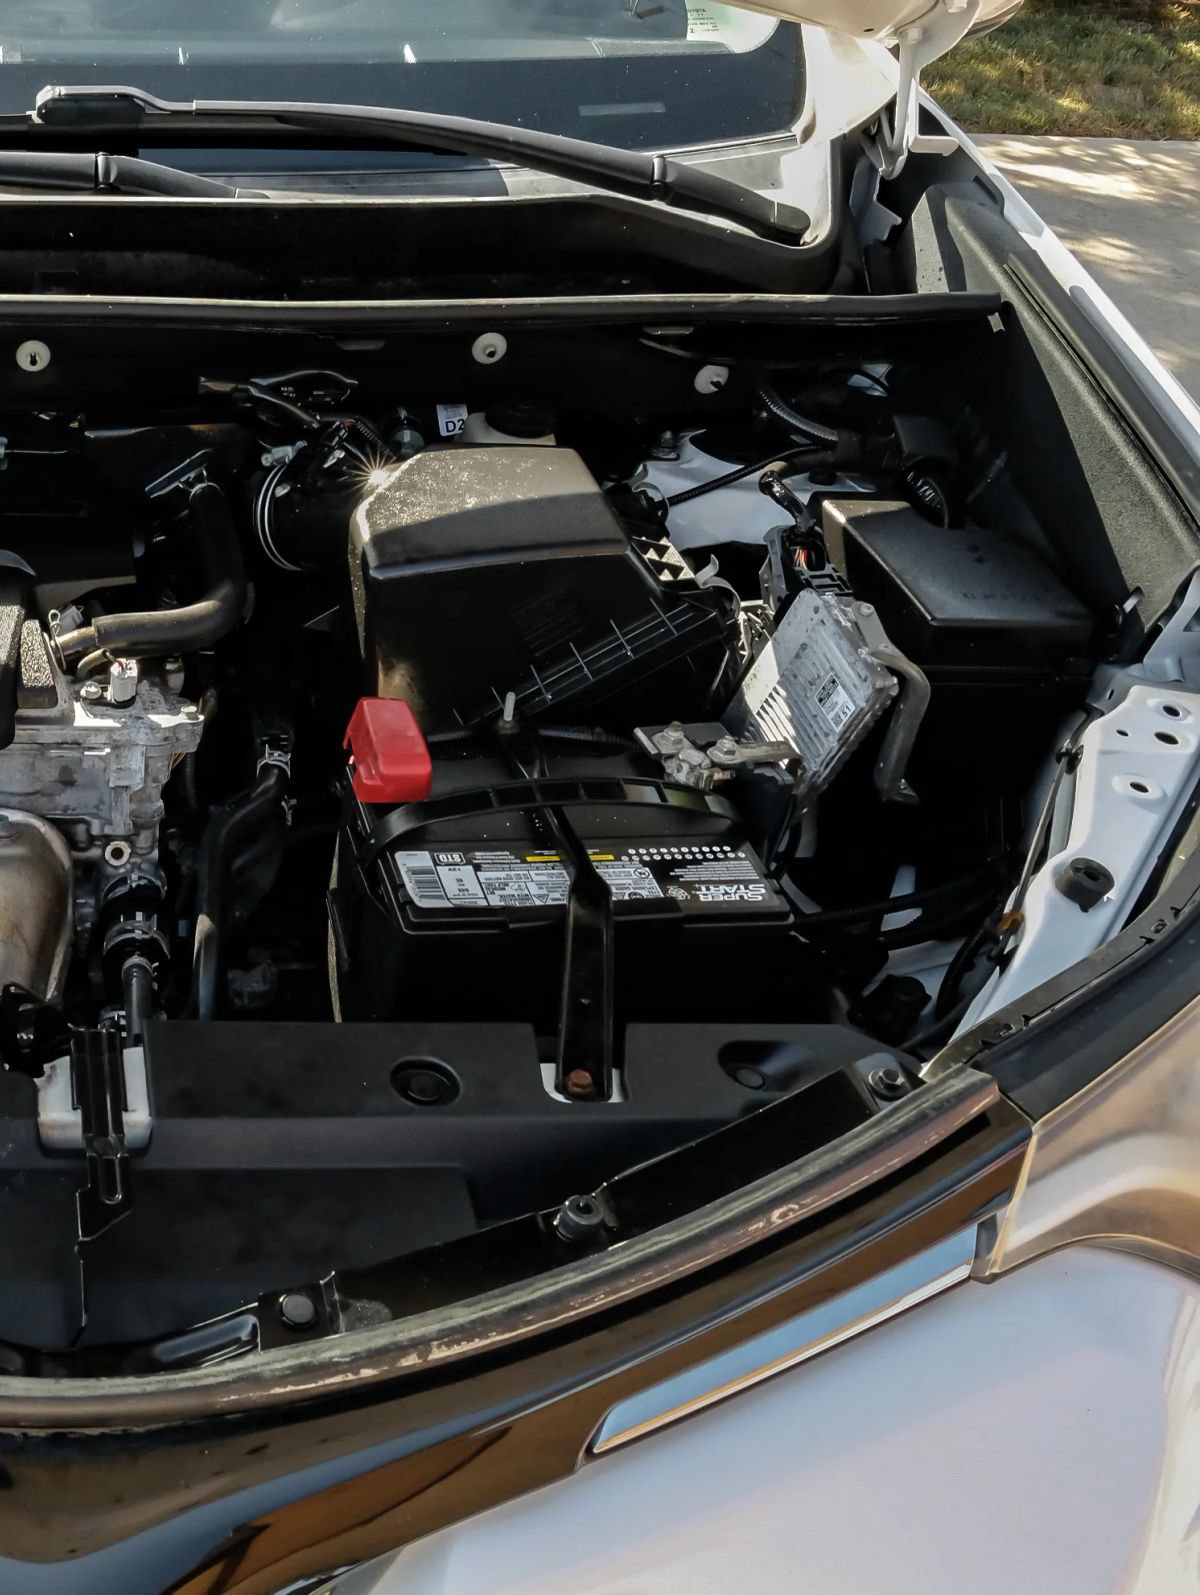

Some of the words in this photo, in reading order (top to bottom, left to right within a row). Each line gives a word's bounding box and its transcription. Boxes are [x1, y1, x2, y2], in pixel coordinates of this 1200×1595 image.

[445, 418, 465, 433] D2
[842, 705, 851, 718] 51
[438, 853, 462, 863] STD
[697, 884, 766, 894] START
[699, 893, 763, 902] SUPER
